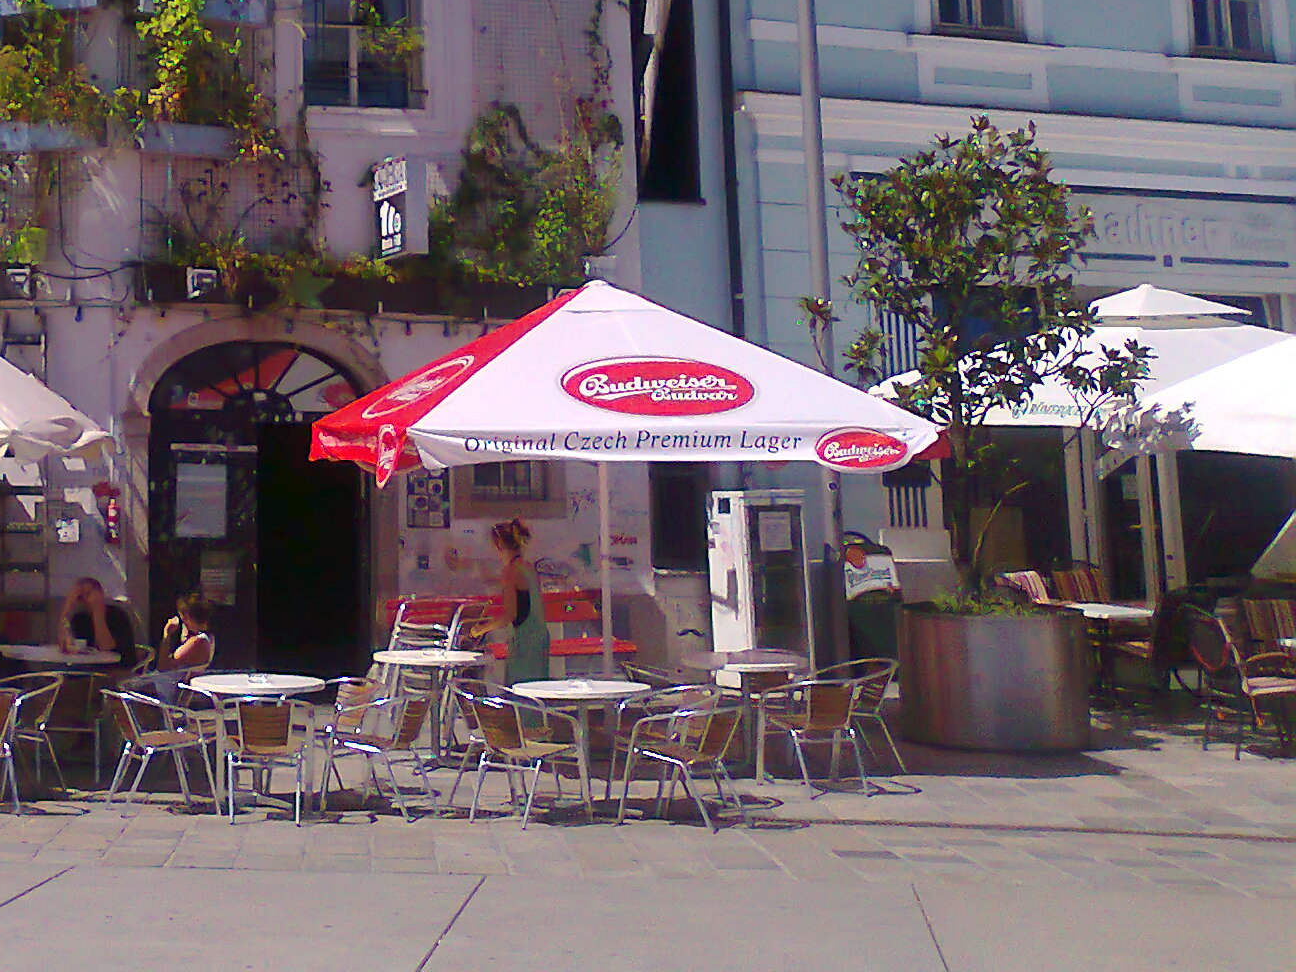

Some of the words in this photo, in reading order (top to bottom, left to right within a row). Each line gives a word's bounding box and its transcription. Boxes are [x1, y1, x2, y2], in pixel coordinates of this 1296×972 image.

[579, 374, 737, 400] Budweiser
[650, 389, 738, 402] Budvar
[464, 433, 556, 454] Original
[564, 431, 628, 450] Czech
[635, 429, 732, 450] Premium
[740, 430, 803, 454] Lager
[824, 441, 901, 461] Budweiser
